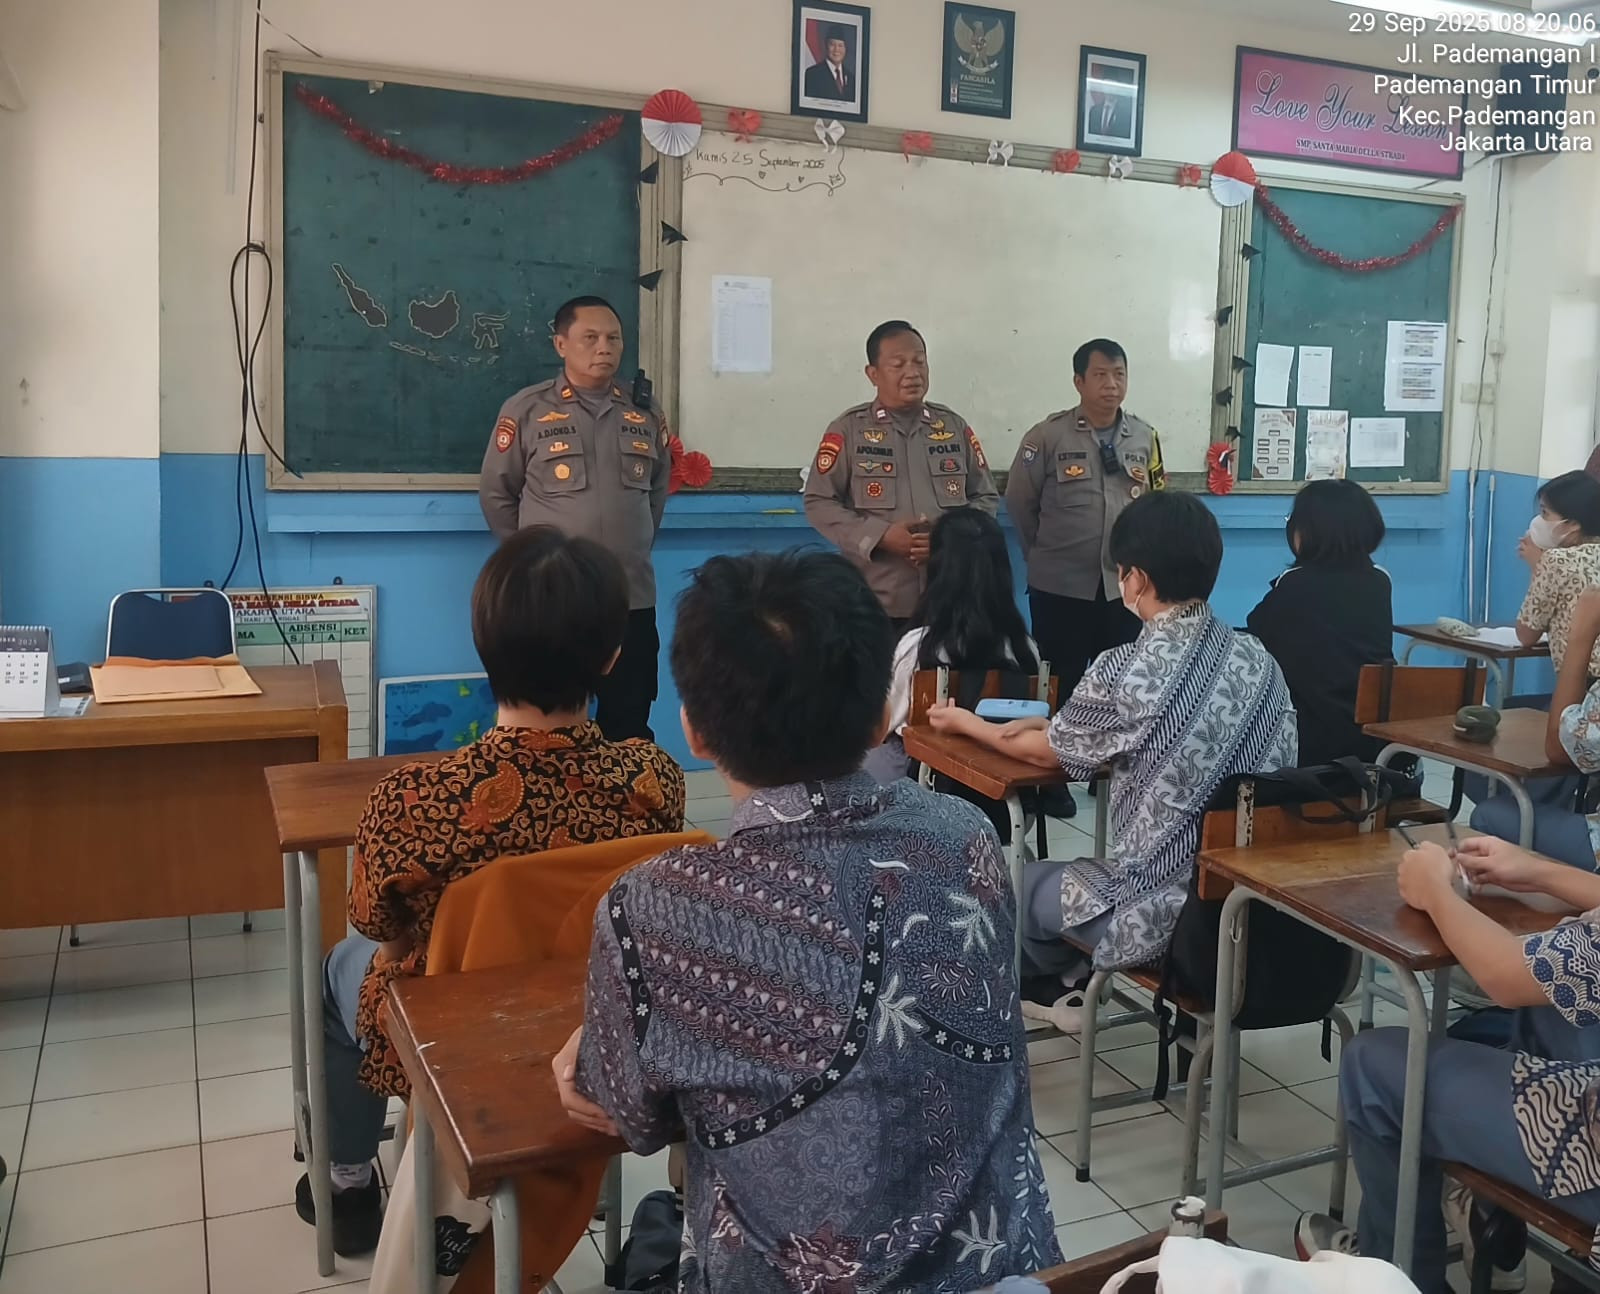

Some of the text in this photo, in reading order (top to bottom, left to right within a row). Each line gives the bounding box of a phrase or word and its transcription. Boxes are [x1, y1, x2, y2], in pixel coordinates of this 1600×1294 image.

[1251, 70, 1310, 121] Love
[1316, 82, 1376, 132] Your
[1296, 139, 1406, 160] SMP SANTA MARIA DELLA STRADA
[731, 151, 753, 165] 25
[928, 444, 961, 455] POLRI
[296, 593, 324, 601] SISWA
[288, 623, 337, 633] ABSENSI
[344, 627, 368, 636] KET
[236, 631, 256, 639] MA
[290, 634, 298, 643] S
[327, 633, 336, 641] A
